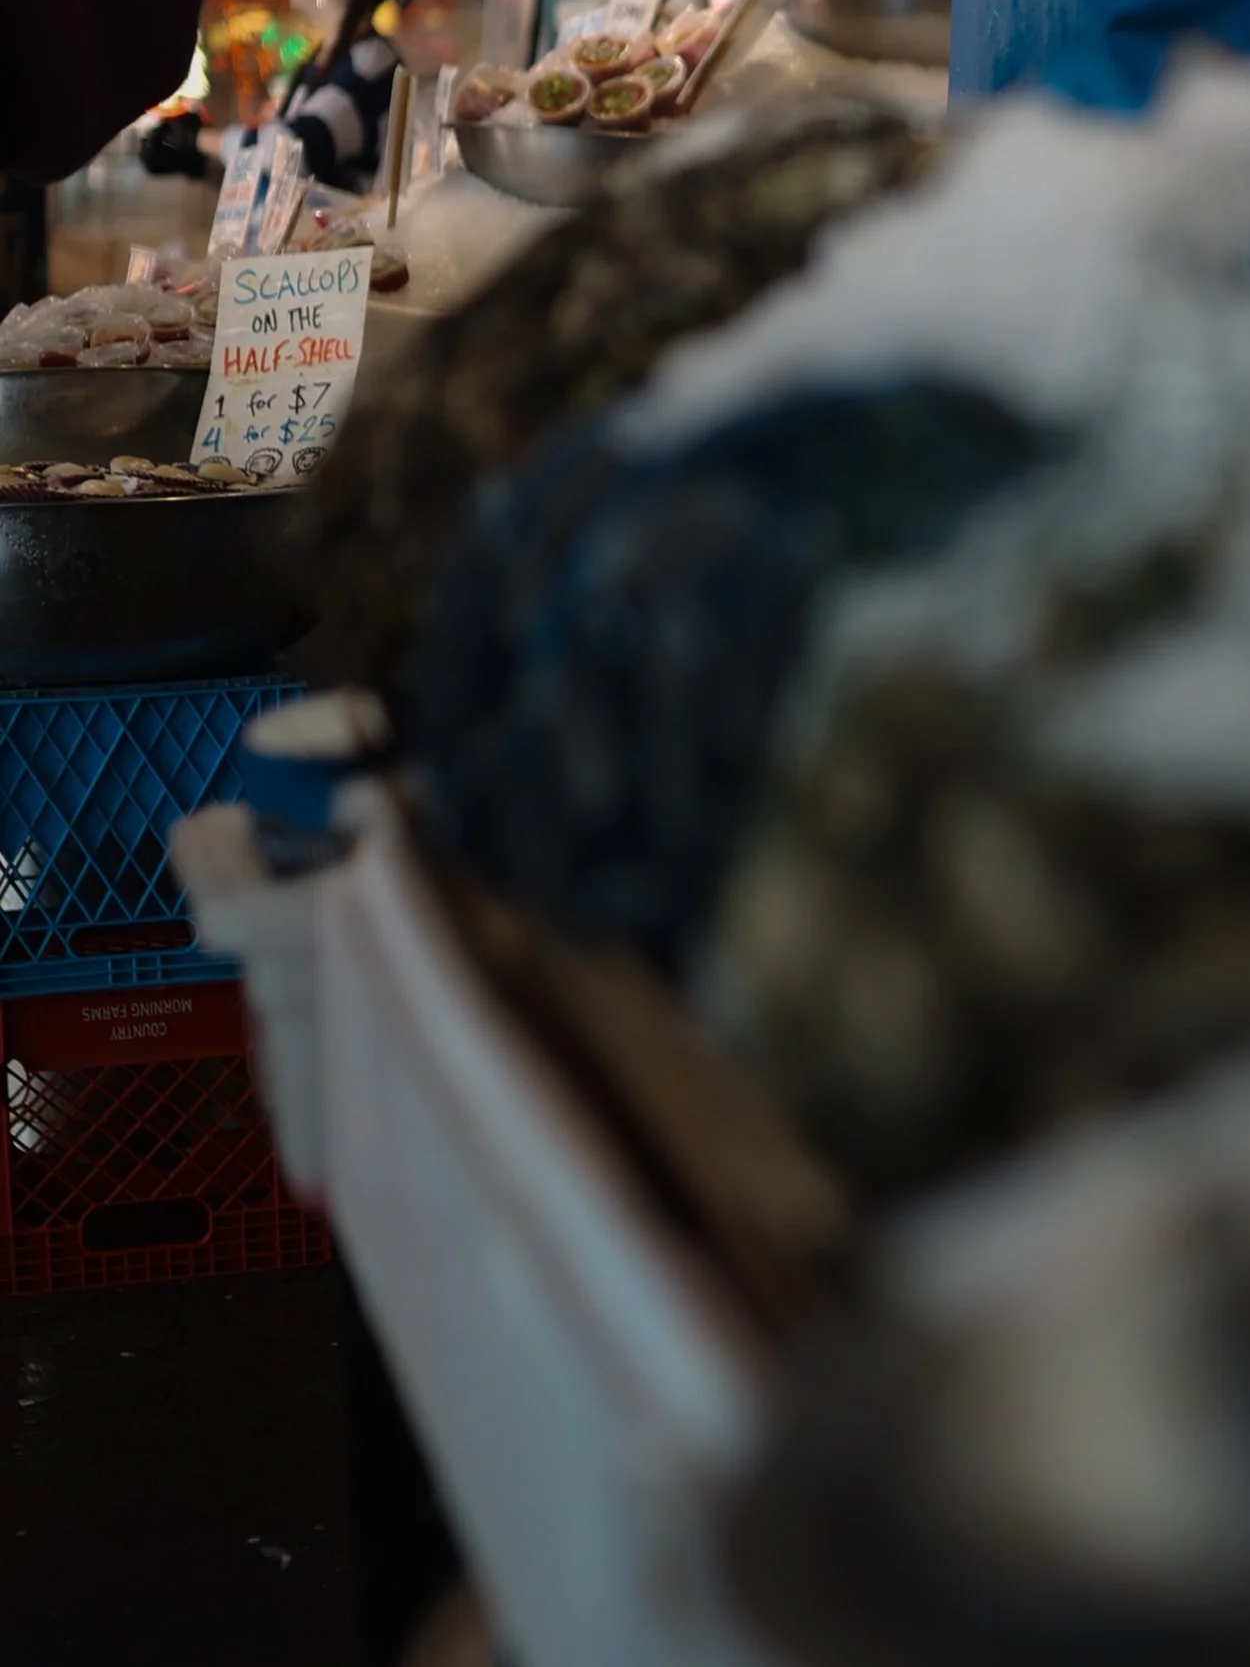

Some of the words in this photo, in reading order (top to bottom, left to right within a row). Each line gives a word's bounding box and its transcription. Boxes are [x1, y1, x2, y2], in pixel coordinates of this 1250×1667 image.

[232, 259, 364, 305] SCALLOPS
[251, 308, 279, 334] ON
[288, 303, 325, 333] THE
[223, 336, 356, 377] HALF-SHELL
[213, 395, 226, 420] 1
[247, 390, 278, 417] for
[288, 382, 332, 415] $7
[201, 426, 223, 453] 4
[243, 425, 269, 443] for
[278, 413, 337, 446] $25
[81, 1002, 128, 1022] FARMS
[130, 998, 193, 1019] MORNING
[110, 1022, 168, 1041] COUNTRY
